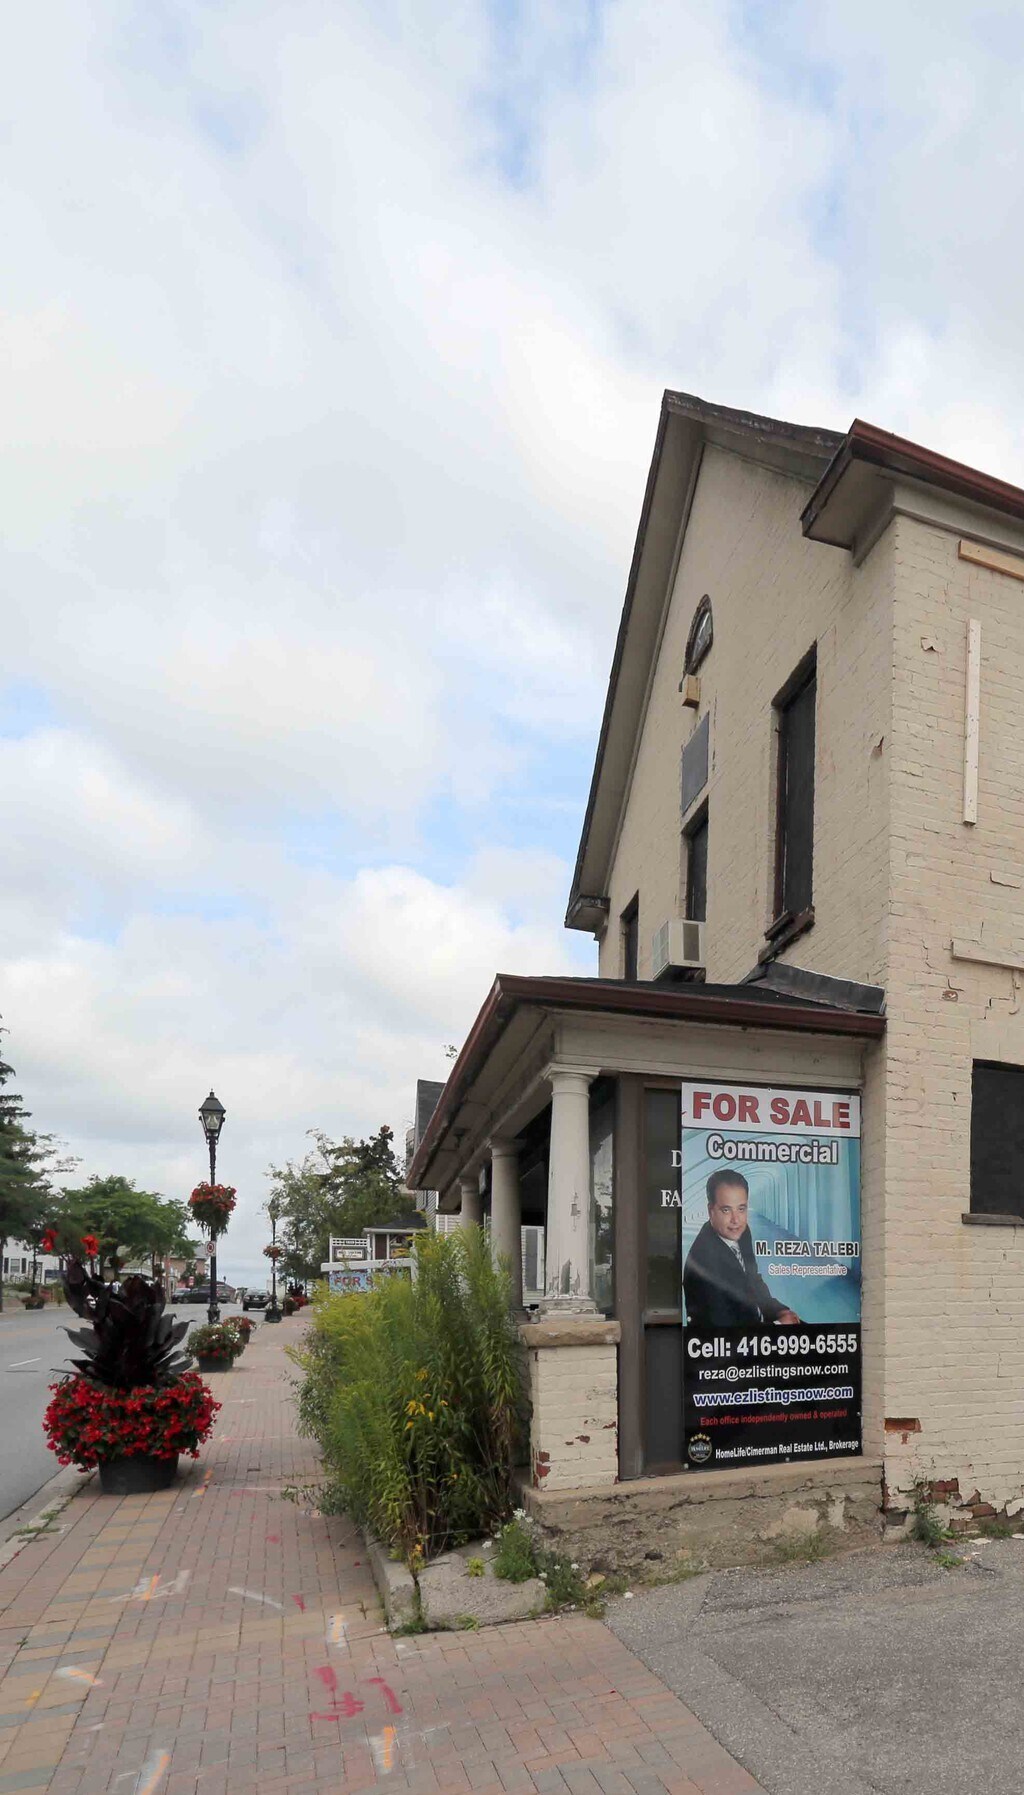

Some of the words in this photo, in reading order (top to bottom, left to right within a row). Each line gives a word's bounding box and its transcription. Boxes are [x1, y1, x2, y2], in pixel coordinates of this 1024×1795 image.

[692, 1091, 760, 1123] FOR
[770, 1097, 851, 1129] SALE
[706, 1133, 838, 1165] Commercial
[756, 1241, 771, 1256] M.
[775, 1241, 810, 1256] REZA
[813, 1242, 859, 1256] TALEBI
[768, 1263, 791, 1275] Sales
[792, 1263, 847, 1277] Representative
[687, 1337, 731, 1358] Cell:
[736, 1333, 858, 1357] 416-999-6555
[699, 1363, 849, 1381] reza@ezlistingsnow.com
[693, 1386, 853, 1407] www.ezlistingsnow.com
[700, 1416, 718, 1426] Each
[720, 1415, 740, 1425] office
[741, 1412, 788, 1424] independently
[789, 1410, 811, 1420] owned
[820, 1408, 848, 1420] operated
[778, 1443, 792, 1454] Real
[793, 1442, 813, 1453] Estate
[828, 1440, 859, 1450] Brokerage
